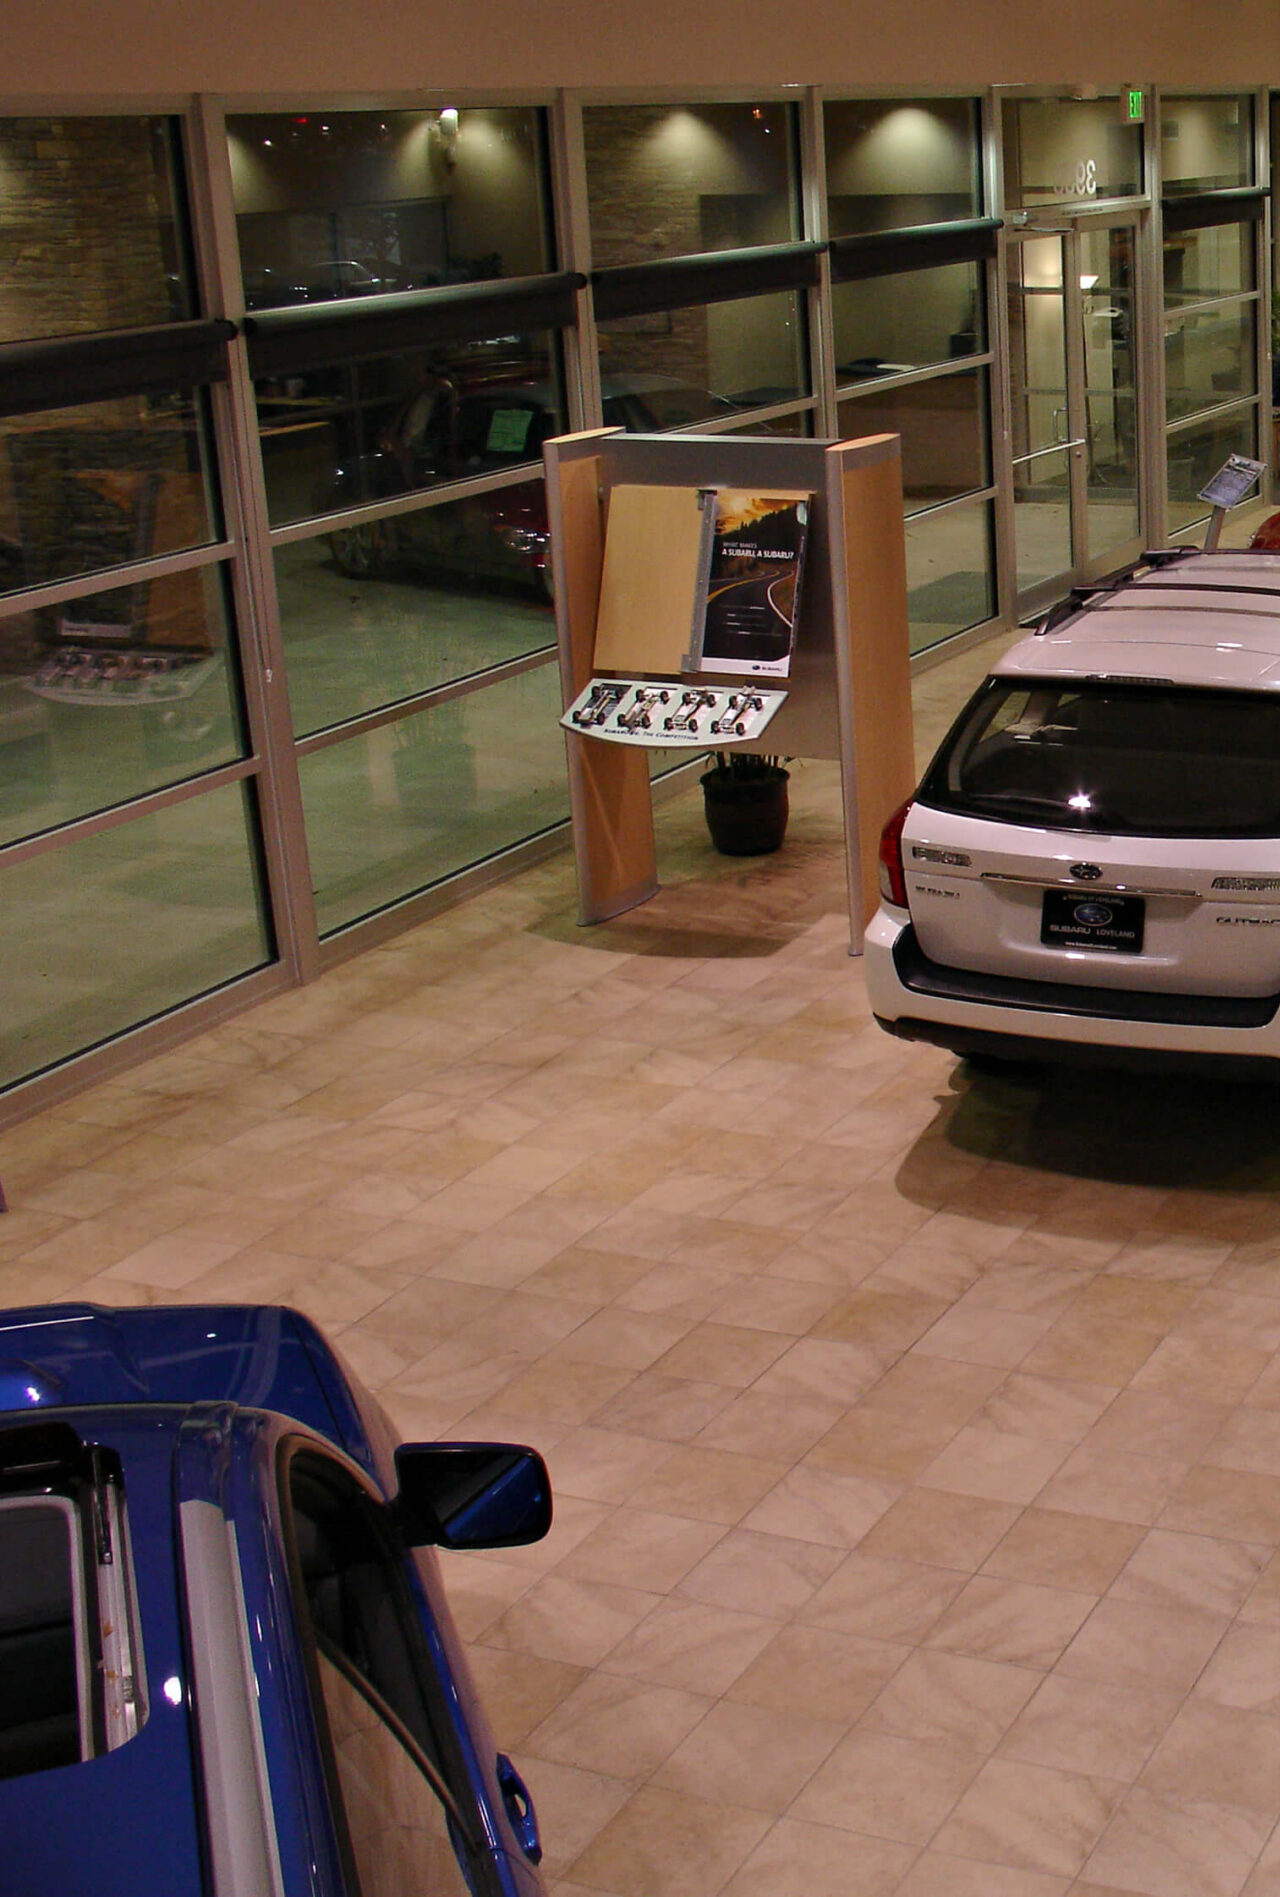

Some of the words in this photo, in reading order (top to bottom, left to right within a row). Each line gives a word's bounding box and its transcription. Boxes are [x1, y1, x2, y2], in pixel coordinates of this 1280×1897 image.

[721, 548, 728, 556] A
[756, 550, 763, 558] A
[1050, 924, 1092, 935] SUBARU
[1096, 928, 1136, 939] LOVELAND
